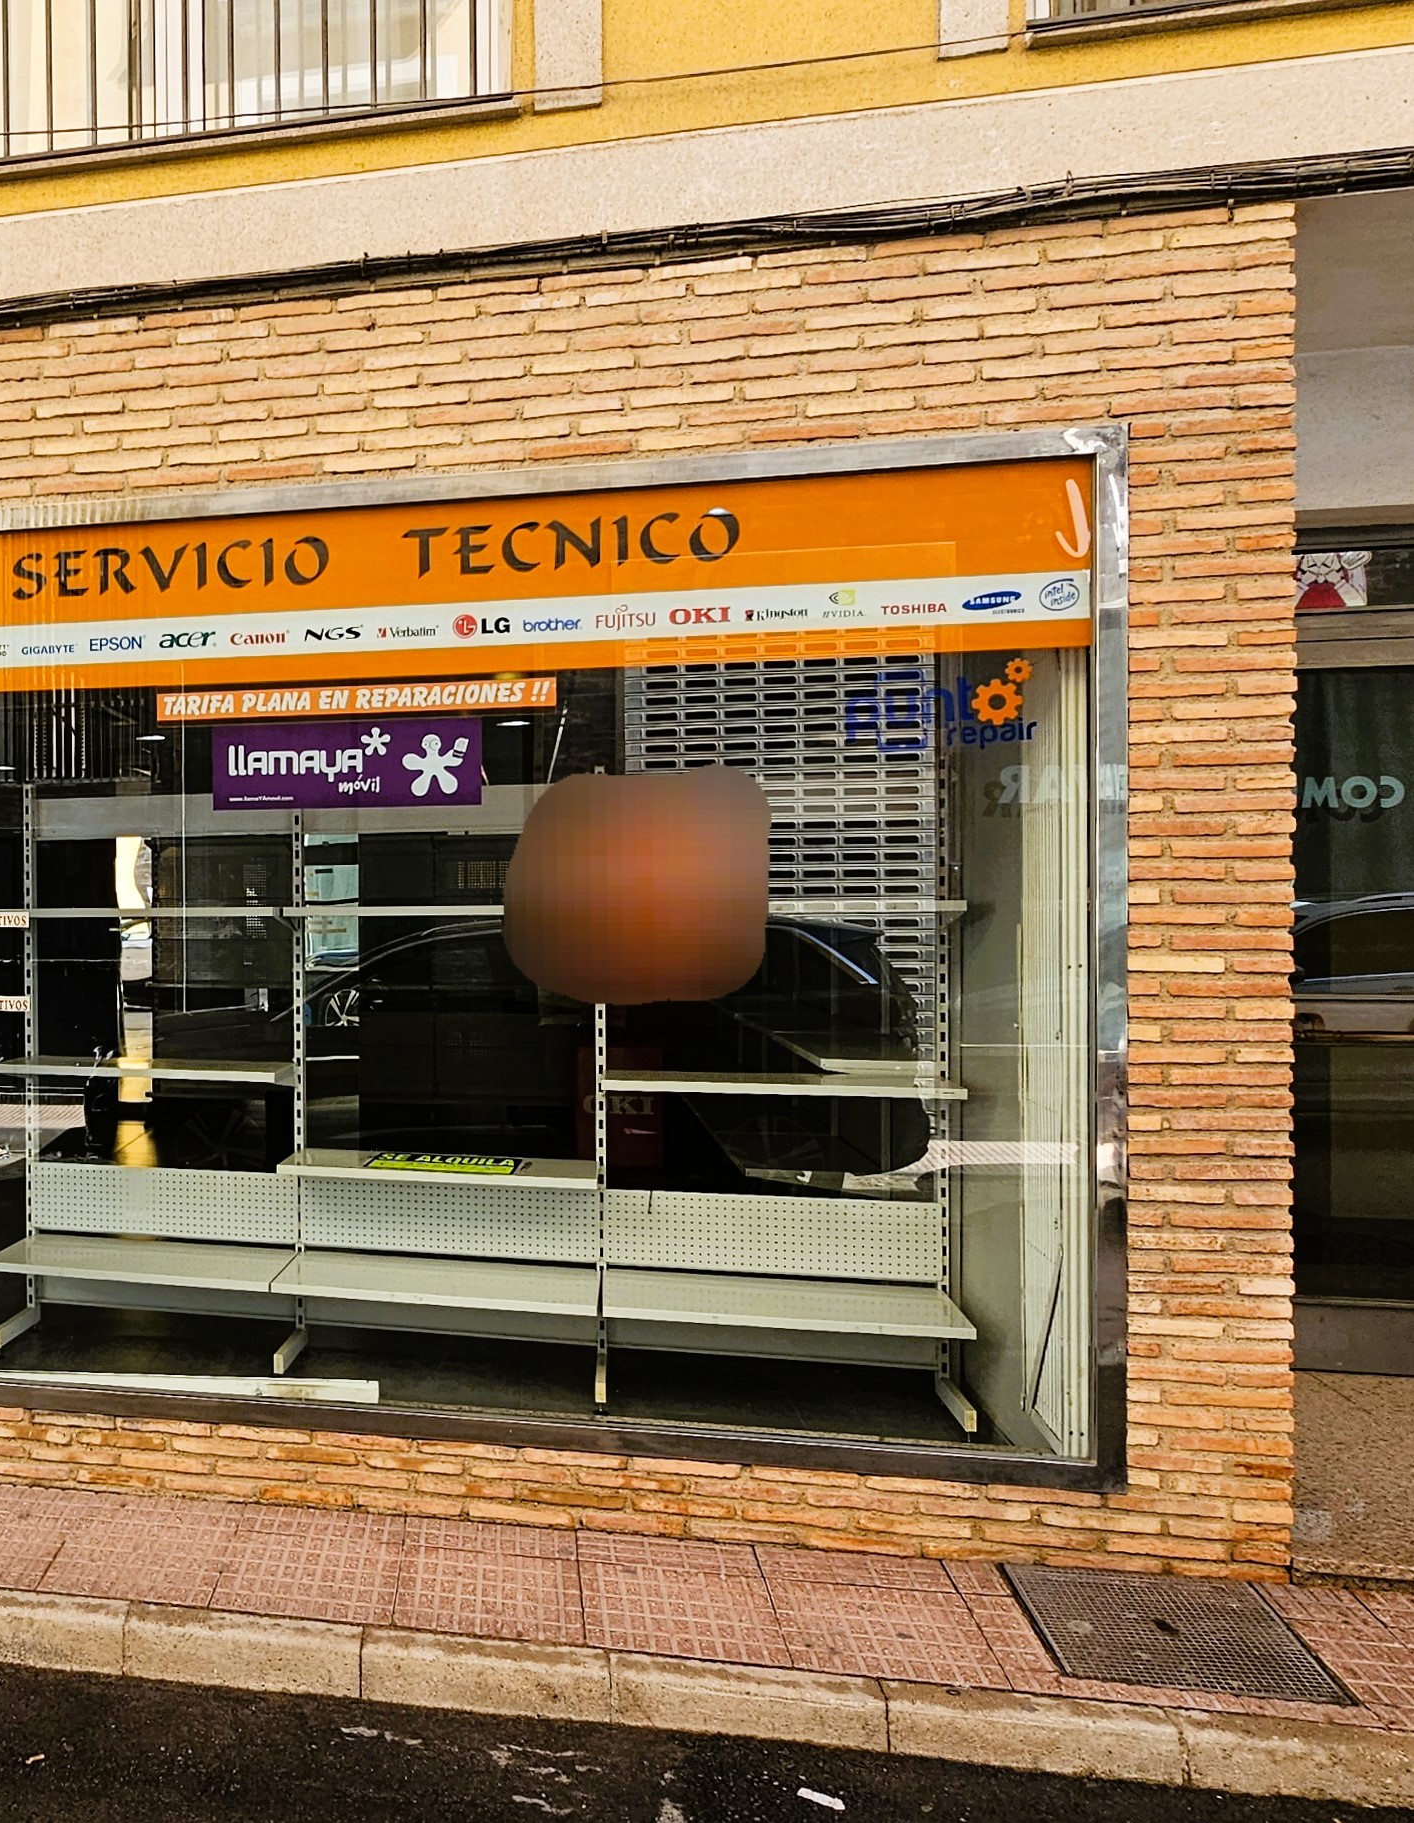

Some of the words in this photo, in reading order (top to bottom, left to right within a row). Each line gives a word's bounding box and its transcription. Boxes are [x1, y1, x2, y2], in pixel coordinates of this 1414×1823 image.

[11, 535, 331, 601] SERVICIO
[401, 509, 741, 580] TECNICO
[1044, 583, 1065, 600] intel
[1049, 590, 1076, 607] inside
[969, 595, 1016, 606] SAMSUNG
[669, 606, 731, 625] OKI
[756, 608, 809, 621] Kingston
[880, 603, 948, 616] TOSHIBA
[481, 617, 511, 634] LG
[522, 618, 581, 633] brother
[595, 606, 656, 632] FUJITSU
[158, 630, 217, 648] acer
[229, 631, 287, 646] Canon
[303, 625, 362, 642] NGS
[389, 626, 437, 638] Verbatim
[21, 644, 75, 655] GIGABYTE
[89, 636, 143, 652] EPSON
[163, 693, 235, 716] TARIFA
[241, 690, 311, 714] PLANA
[319, 688, 350, 711] EN
[355, 681, 525, 710] REPARACIONES
[945, 716, 1038, 750] repair
[378, 1152, 411, 1161] SE
[414, 1154, 516, 1167] ALQUILA
